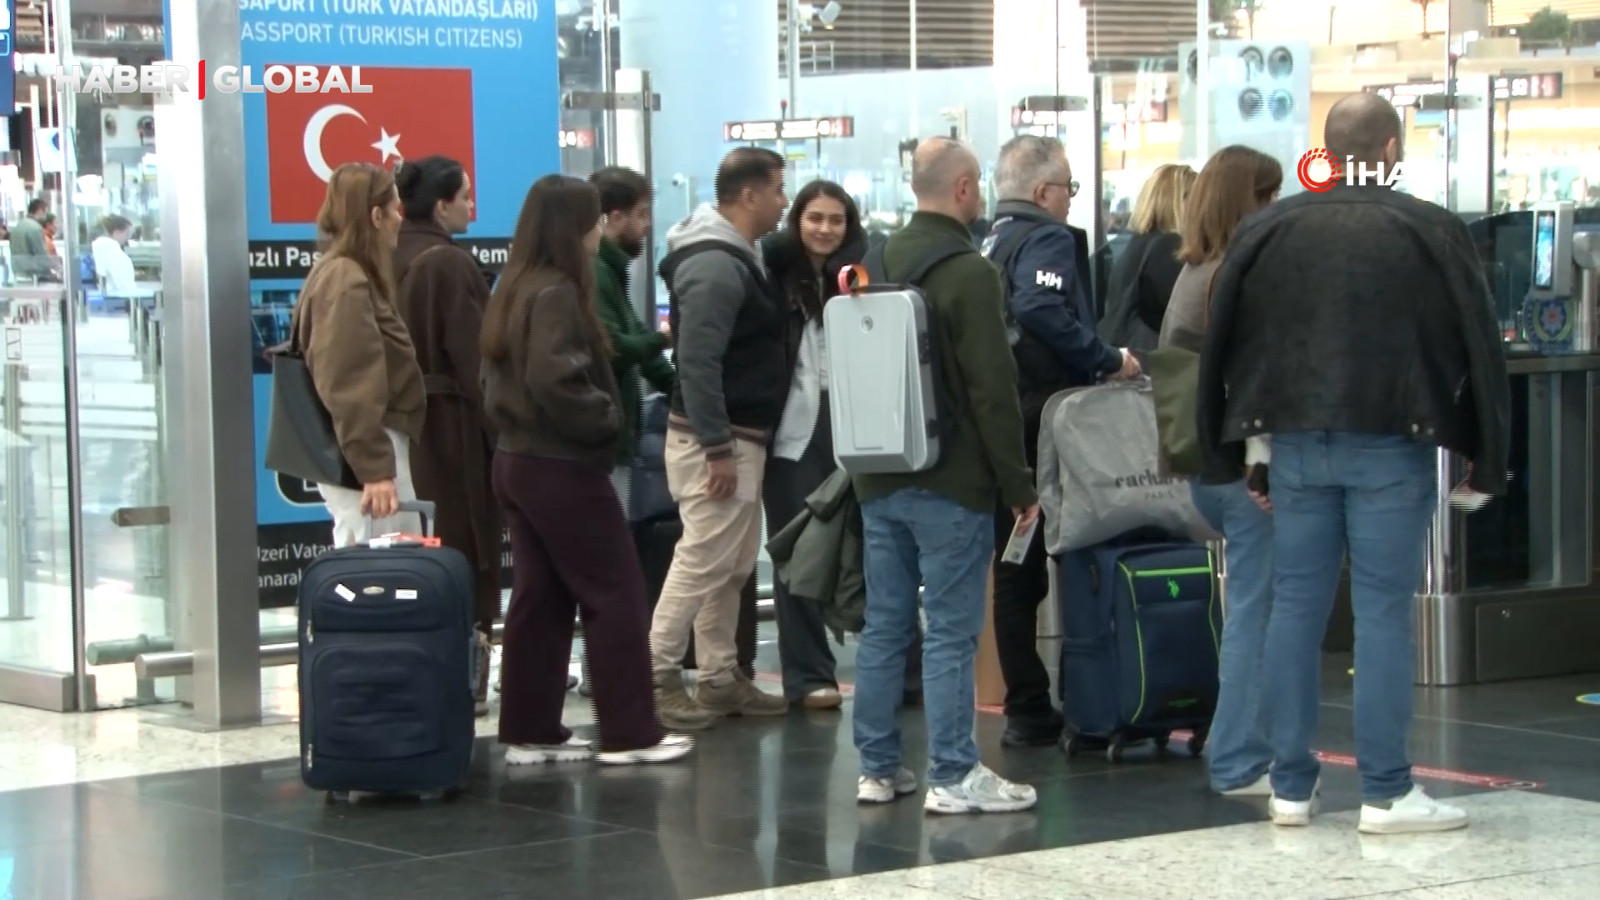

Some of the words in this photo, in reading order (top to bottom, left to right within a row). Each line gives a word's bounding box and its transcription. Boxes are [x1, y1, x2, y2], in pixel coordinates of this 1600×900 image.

[240, 21, 334, 43] ASSPORT
[340, 23, 430, 47] (TURKISH
[435, 26, 523, 49] CITIZENS)
[1036, 270, 1062, 290] HH
